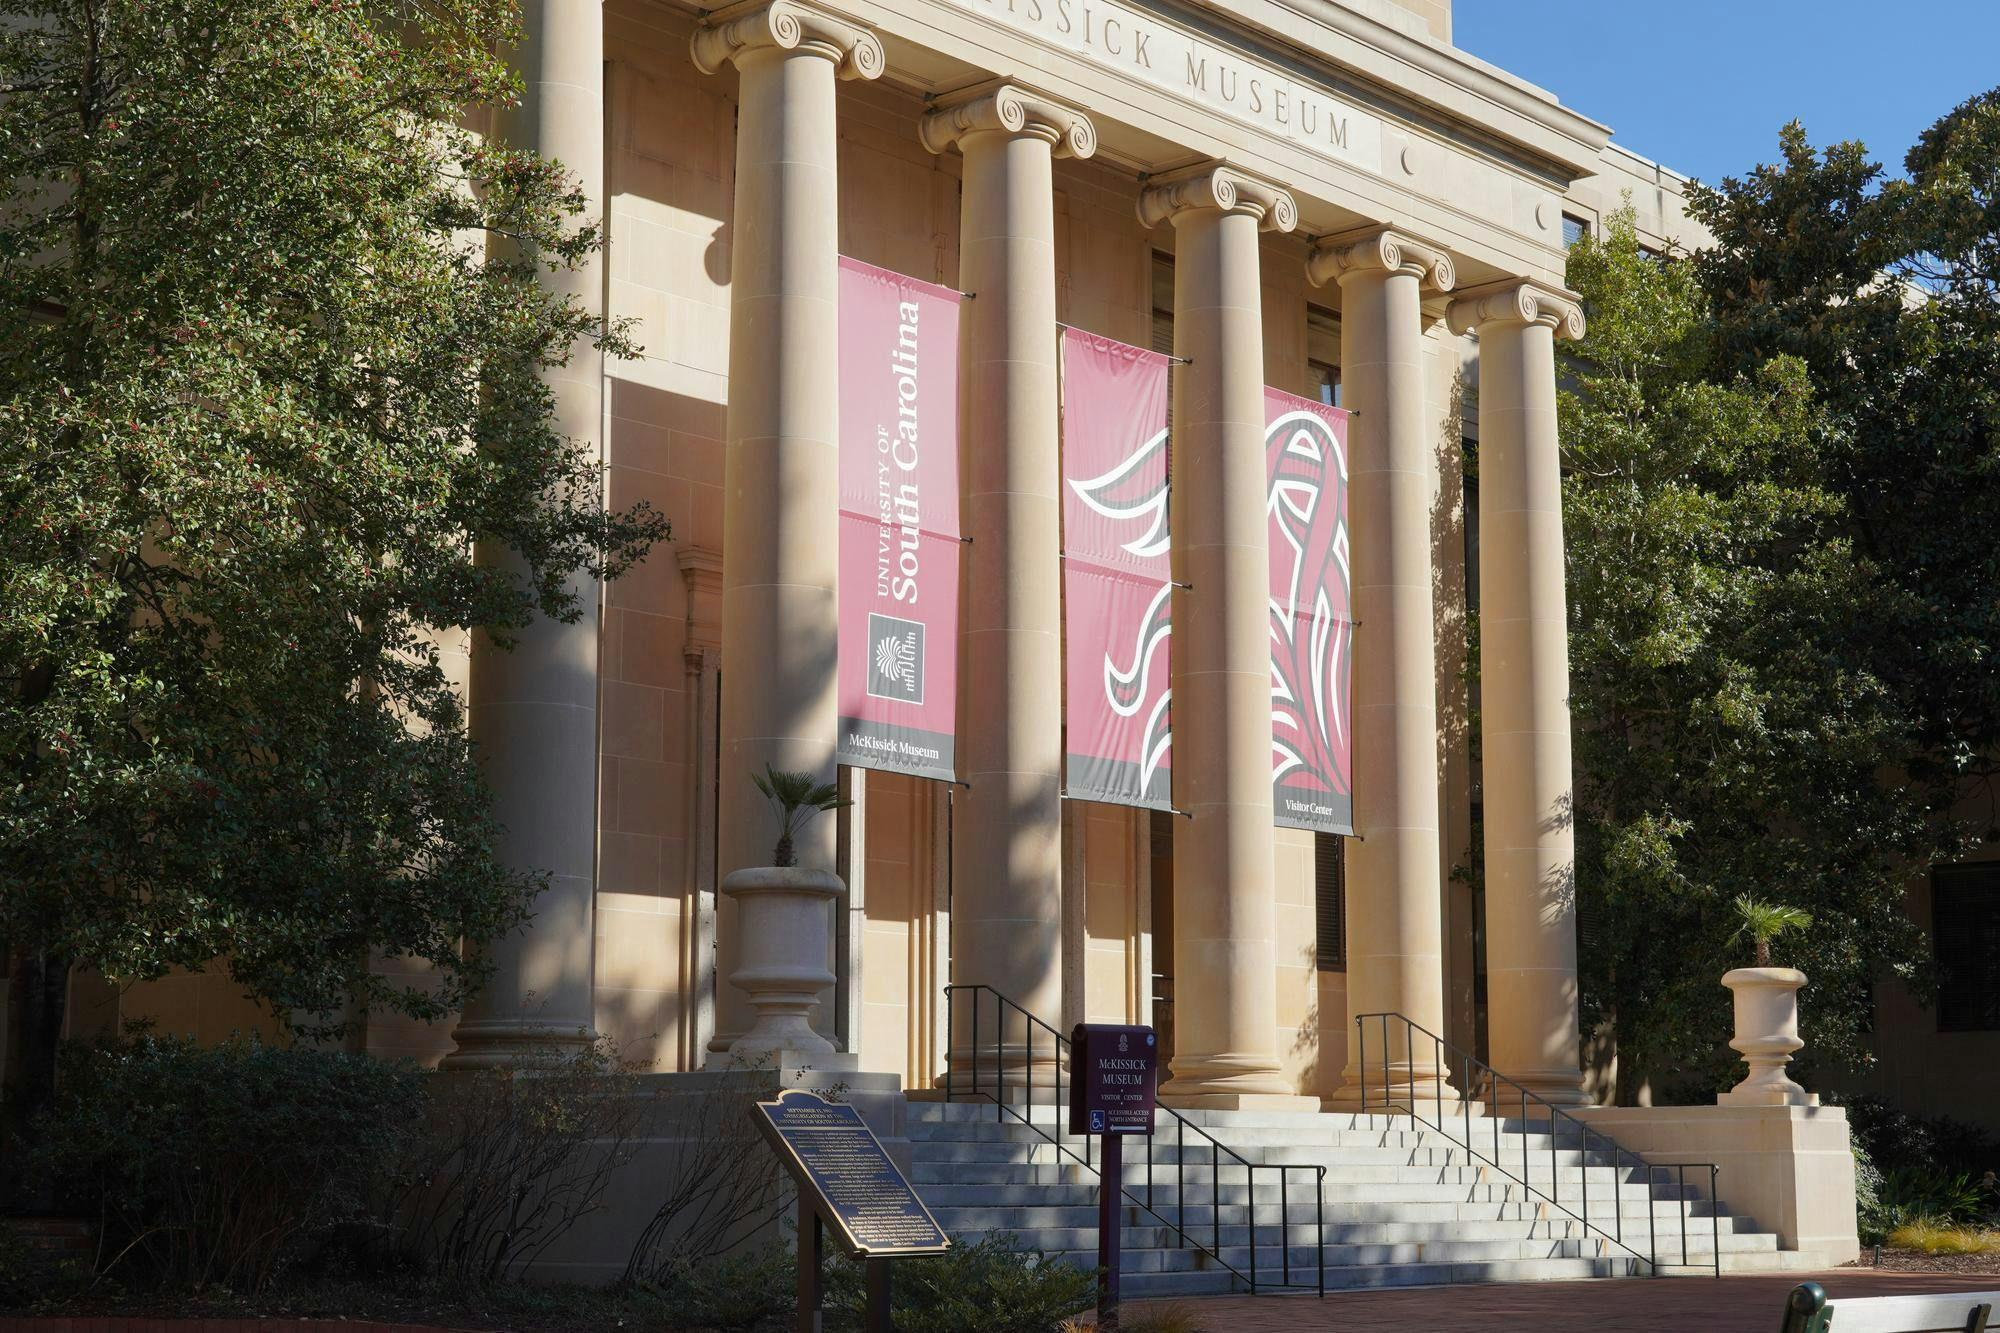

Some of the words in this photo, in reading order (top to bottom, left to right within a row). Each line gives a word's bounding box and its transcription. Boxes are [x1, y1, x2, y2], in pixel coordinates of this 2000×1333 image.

[1187, 51, 1350, 151] MUSEUM
[892, 302, 919, 471] Carolina
[877, 424, 889, 453] OF
[877, 461, 891, 598] UNIVERSITY
[892, 484, 919, 604] South
[849, 733, 897, 752] McKissick
[899, 742, 939, 759] Museum
[1285, 799, 1310, 813] Visitor
[1310, 802, 1333, 815] Center
[1102, 1074, 1142, 1085] MUSEUM
